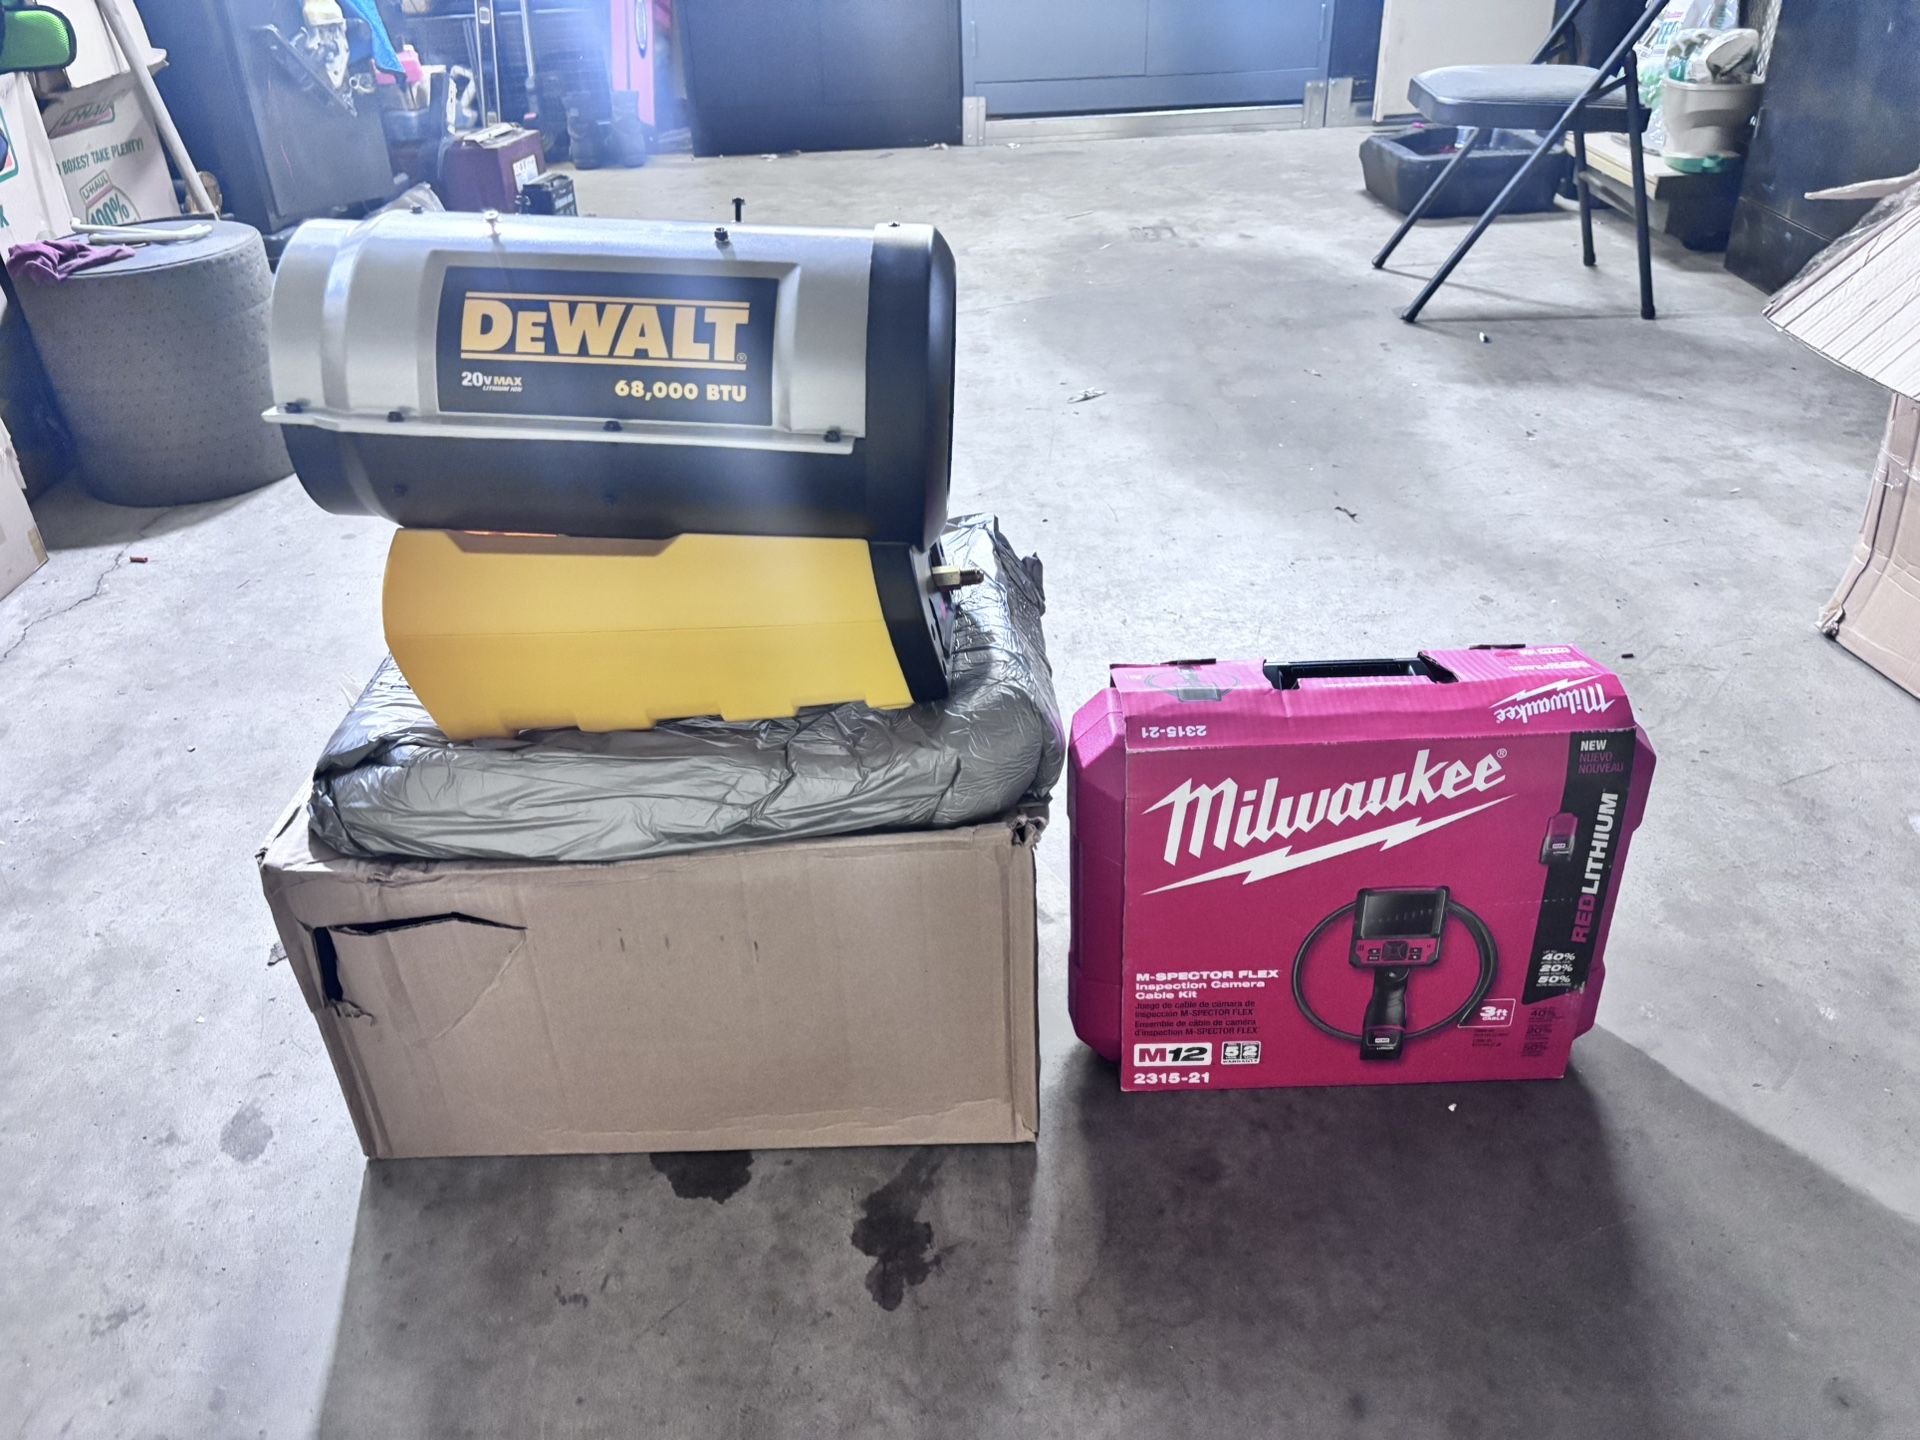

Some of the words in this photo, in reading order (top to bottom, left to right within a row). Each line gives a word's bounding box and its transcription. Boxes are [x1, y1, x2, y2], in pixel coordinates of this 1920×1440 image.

[62, 153, 90, 175] BOXES?
[90, 146, 110, 164] TAKE
[110, 137, 144, 158] PLENTY!
[82, 175, 109, 200] U-HAUL
[493, 376, 522, 386] MAX
[614, 379, 699, 401] 68,000
[706, 384, 747, 402] BTU
[1141, 724, 1207, 738] 2315-21
[1580, 739, 1607, 751] NEW
[1541, 952, 1576, 961] 40%
[1539, 964, 1573, 972] 20%
[1135, 970, 1234, 982] M-SPECTOR
[1238, 969, 1279, 979] FLEX
[1135, 981, 1207, 991] Inspection
[1210, 980, 1265, 988] Camera
[1135, 991, 1175, 1000] Cable
[1178, 990, 1198, 998] Kit
[1162, 1001, 1173, 1009] de
[1180, 1009, 1230, 1017] M-SPECTOR
[1232, 1008, 1254, 1016] FLEX
[1479, 1005, 1509, 1017] 3ft
[1212, 1019, 1224, 1027] de
[1185, 1027, 1235, 1036] M-SPECTOR
[1138, 1046, 1208, 1063] M12
[1133, 1071, 1211, 1085] 2315-21
